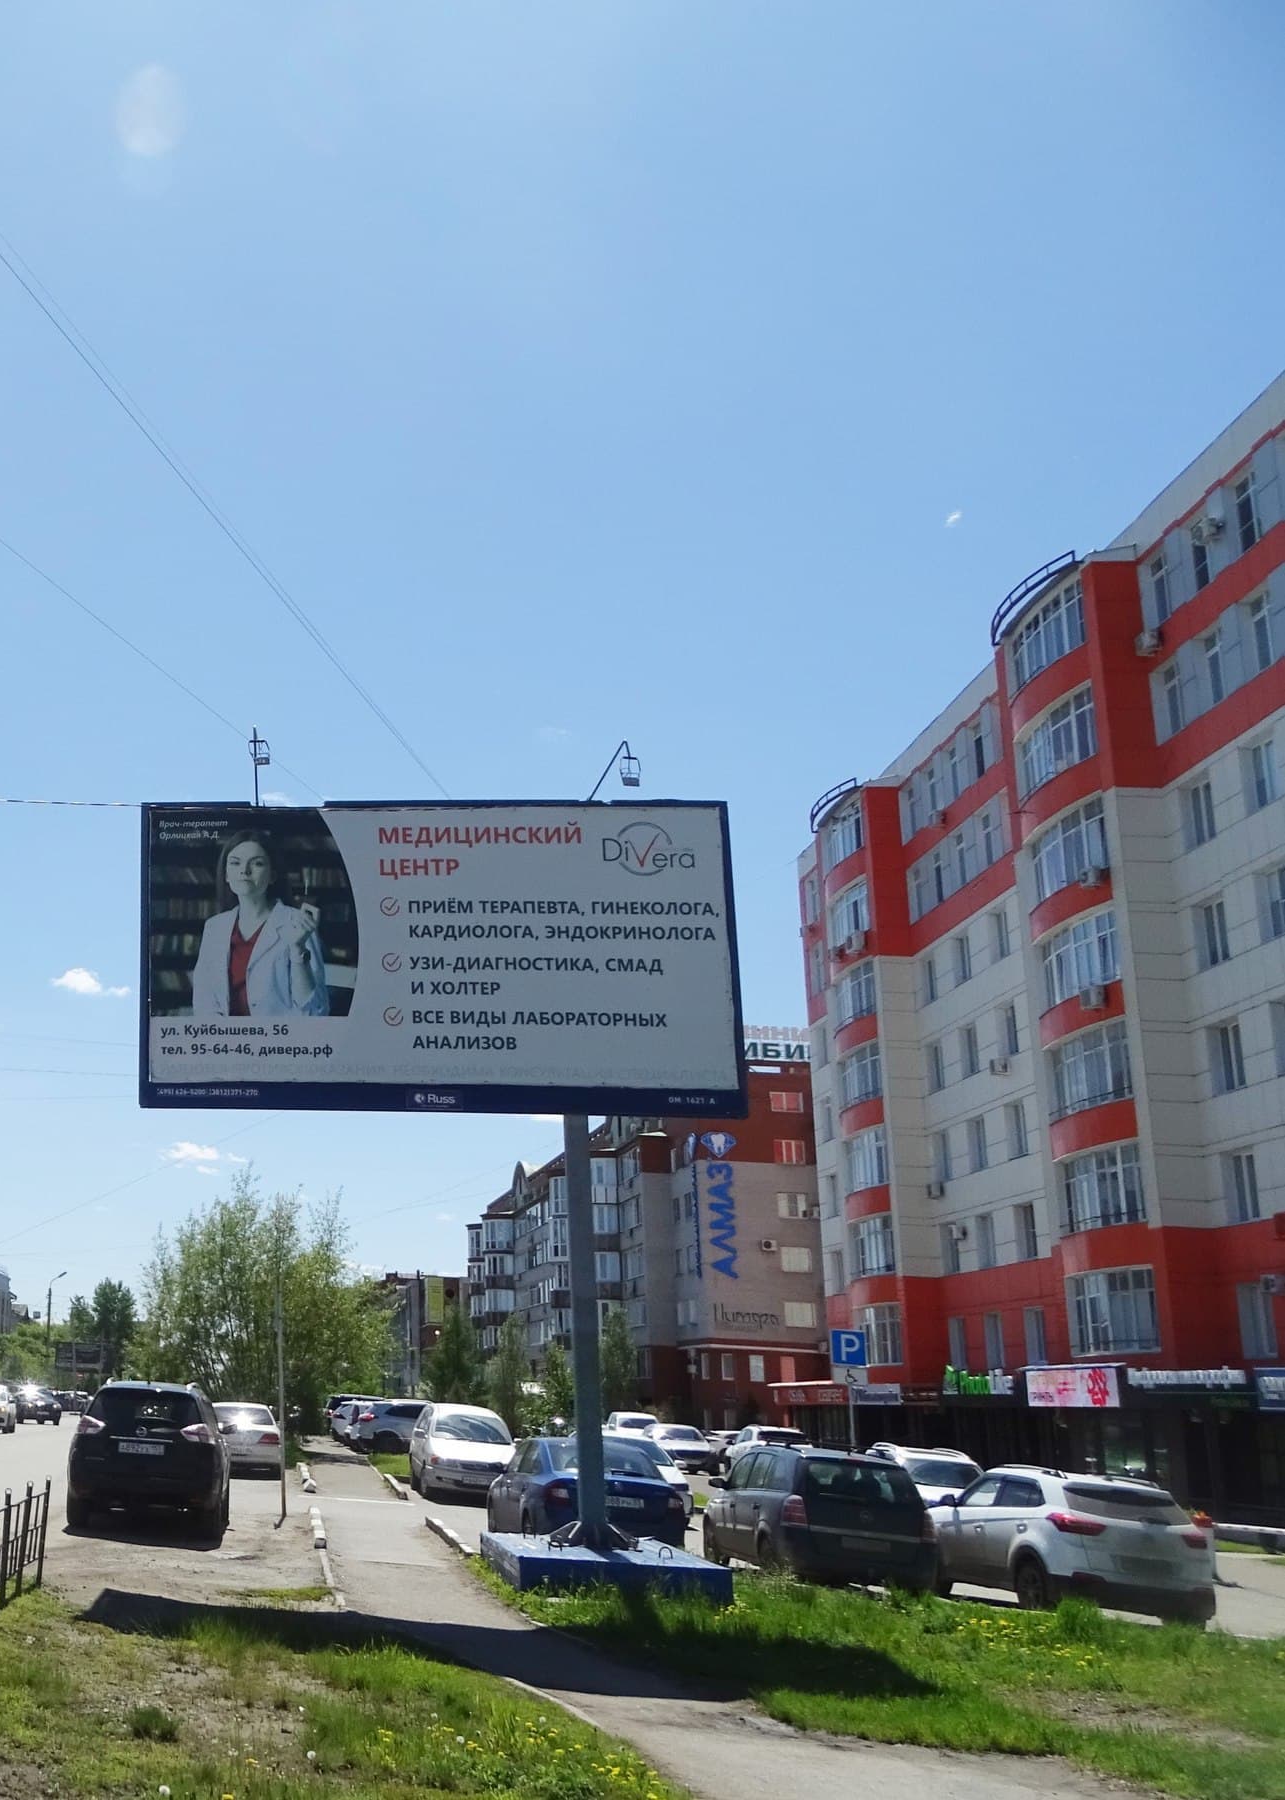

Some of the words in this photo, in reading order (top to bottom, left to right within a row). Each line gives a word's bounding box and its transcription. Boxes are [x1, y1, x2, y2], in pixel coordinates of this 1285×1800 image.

[378, 821, 583, 848] МЕДИЦИНСКИЙ
[602, 833, 696, 869] DiVera
[379, 858, 460, 880] ЦЕНТР
[408, 897, 473, 915] ПРИЁМ
[479, 900, 585, 917] ТЕРАПЕВТА,
[591, 901, 719, 918] ГИНЕКОЛОГА,
[408, 924, 539, 941] КАРДИОЛОГА,
[545, 925, 716, 941] ЭНДОКРИНОЛОГА
[409, 956, 600, 974] УЗИ-ДИАГНОСТИКА,
[605, 958, 664, 975] СМАД
[411, 981, 424, 995] И
[430, 981, 501, 996] ХОЛТЕР
[412, 1010, 444, 1024] ВСЕ
[450, 1010, 506, 1027] ВИДЫ
[512, 1011, 667, 1028] ЛАБОРАТОРНЫХ
[160, 1027, 180, 1038] ул.
[184, 1024, 268, 1038] Куйбышева,
[272, 1024, 289, 1036] 56
[161, 1045, 186, 1056] тел.
[191, 1044, 255, 1057] 95-64-46,
[258, 1044, 333, 1058] дивера.рф
[412, 1035, 518, 1051] АНАЛИЗОВ
[427, 1093, 456, 1104] Russ
[706, 1162, 740, 1280] АЛМАЗ
